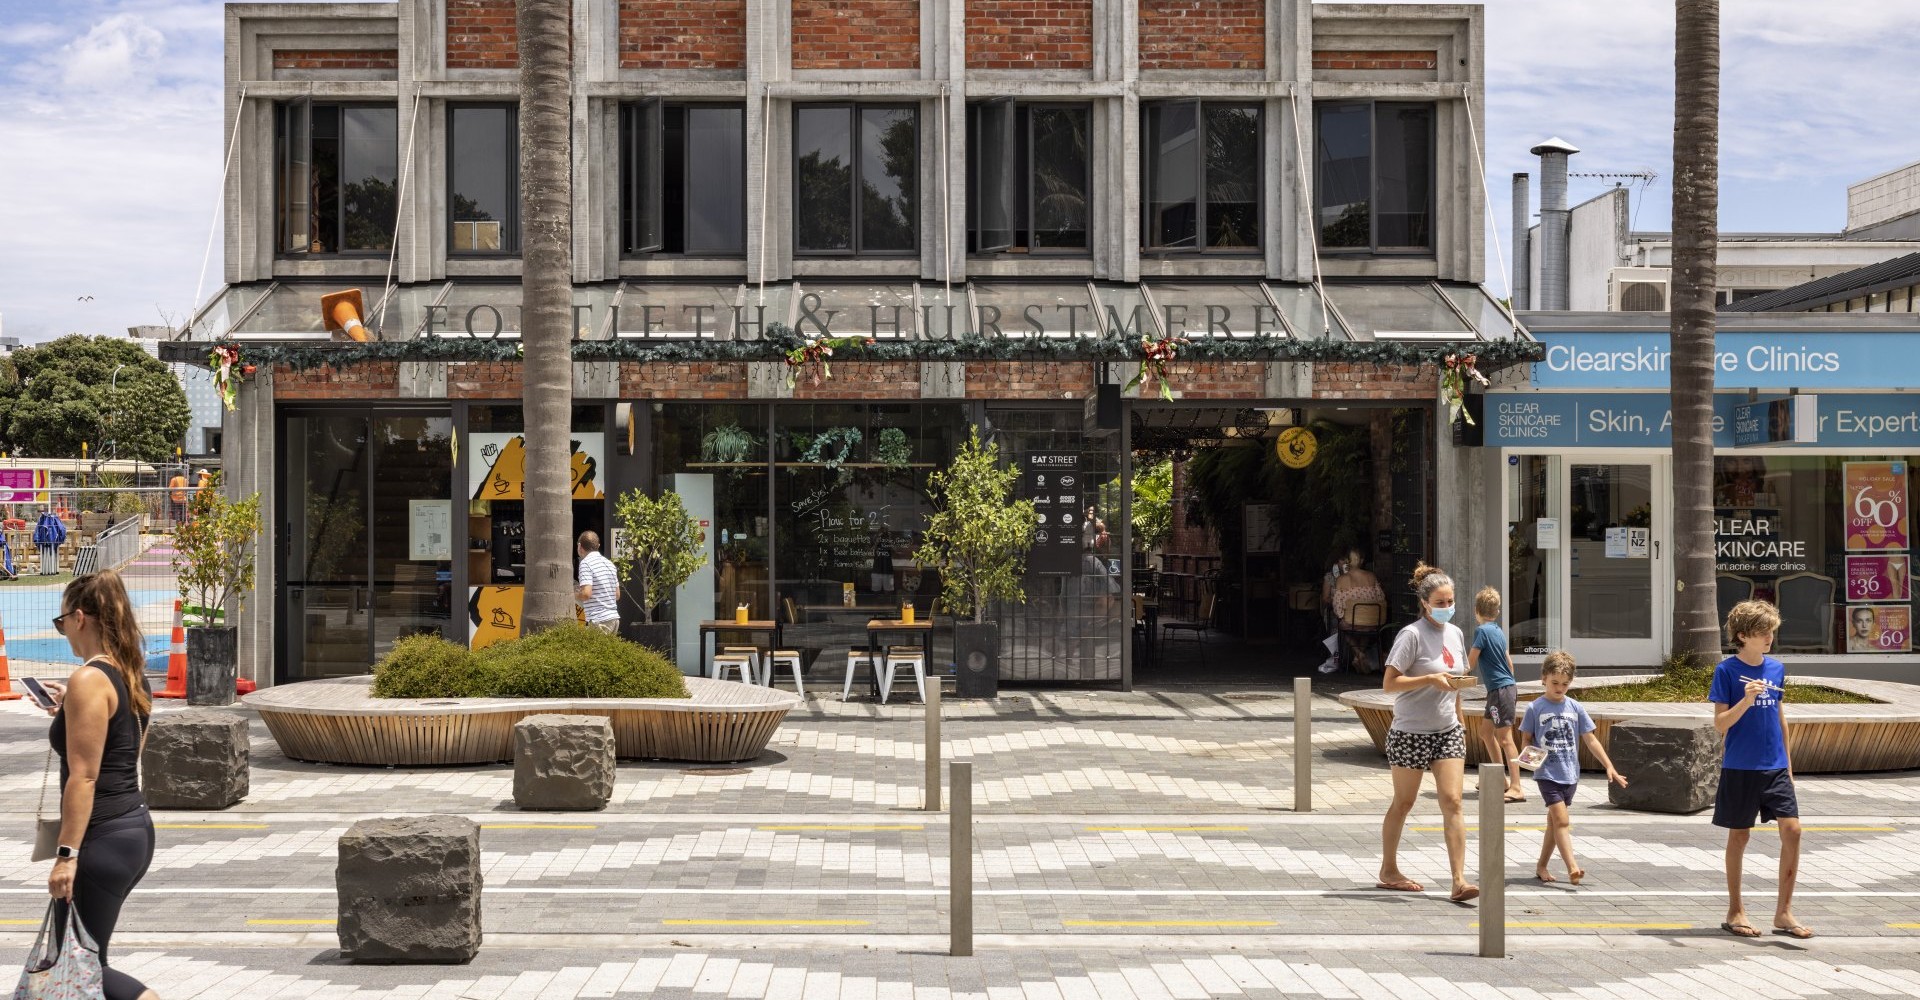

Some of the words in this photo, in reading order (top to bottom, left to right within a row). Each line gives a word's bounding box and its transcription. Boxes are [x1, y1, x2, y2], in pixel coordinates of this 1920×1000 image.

[423, 304, 768, 341] FOTIETH
[795, 293, 839, 339] &
[867, 304, 1280, 341] HURSTMERE
[1547, 345, 1738, 372] Clearskinre
[1746, 345, 1840, 372] Clinics
[1499, 402, 1540, 414] CLEAR
[1735, 406, 1751, 420] CLEAR
[1499, 414, 1561, 426] SKINCARE
[1588, 409, 1651, 436] Skin,
[1659, 410, 1725, 432] Ae
[1735, 419, 1759, 434] SKINCARE
[1499, 426, 1548, 438] CLINICS
[1031, 455, 1048, 464] EAT
[1048, 455, 1078, 464] STREET
[791, 497, 813, 513] SAVE
[1854, 486, 1902, 528] 60%
[848, 509, 865, 527] for
[868, 511, 879, 526] 2
[1852, 518, 1873, 527] OFF
[817, 534, 829, 544] 2x
[833, 534, 871, 548] baguettes
[1631, 538, 1645, 547] NZ
[1780, 561, 1806, 571] clinics
[1850, 574, 1880, 596] $36
[1874, 630, 1904, 647] $60
